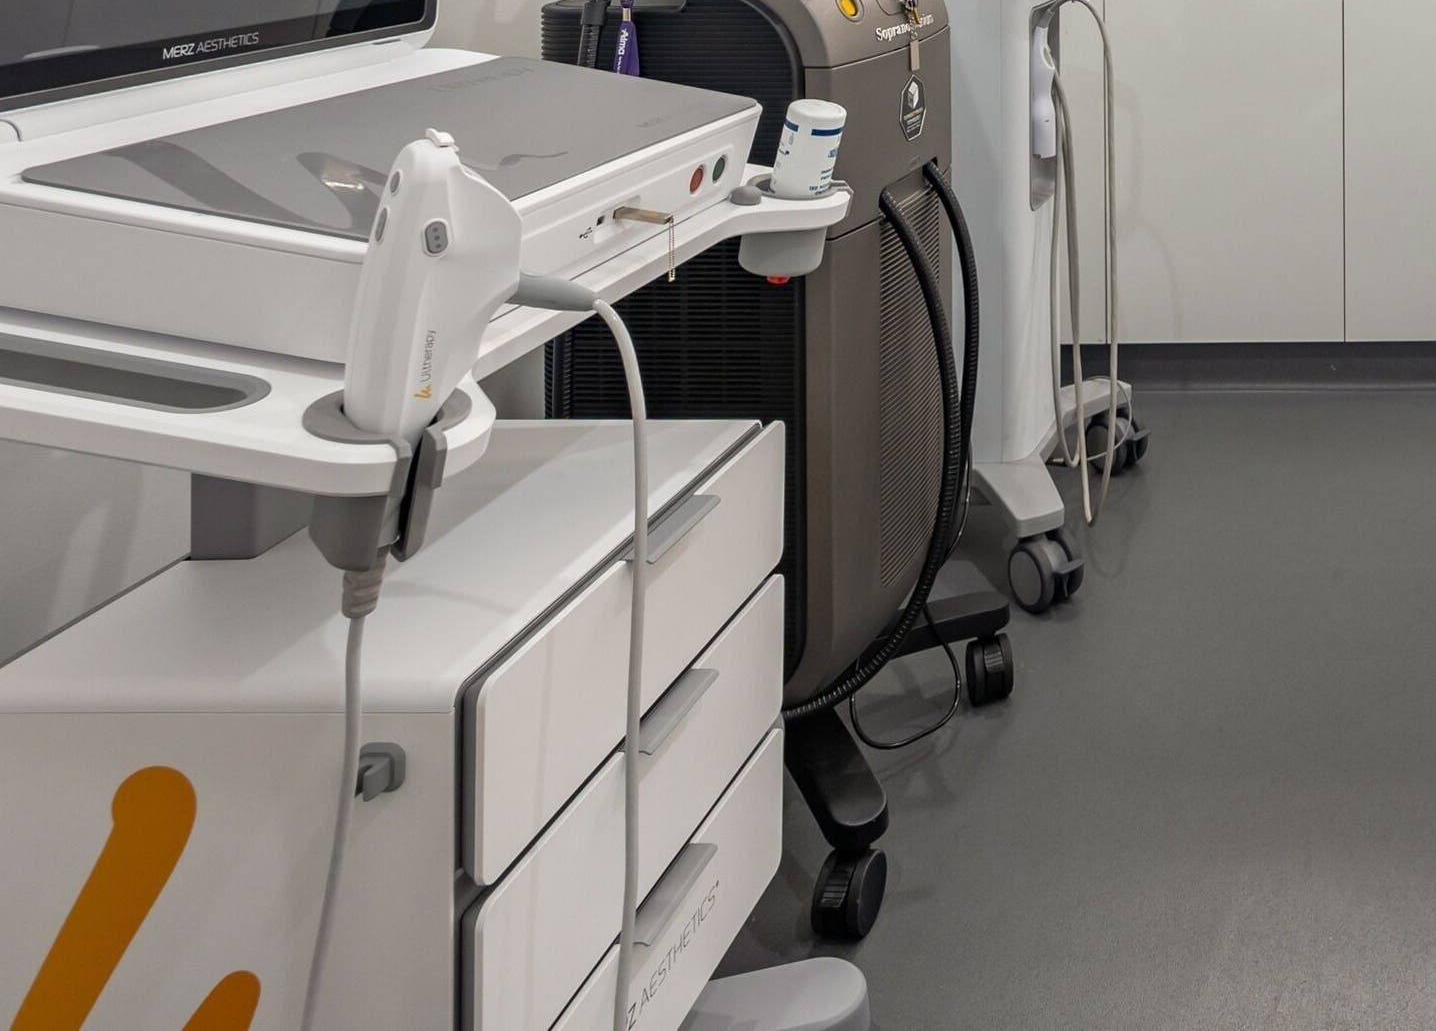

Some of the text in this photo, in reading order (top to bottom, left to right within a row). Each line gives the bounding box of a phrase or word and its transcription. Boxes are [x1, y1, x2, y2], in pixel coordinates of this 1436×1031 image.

[162, 32, 260, 60] MERZ AESTHETICS
[875, 23, 911, 42] Soprano
[420, 330, 436, 383] Ultherapy
